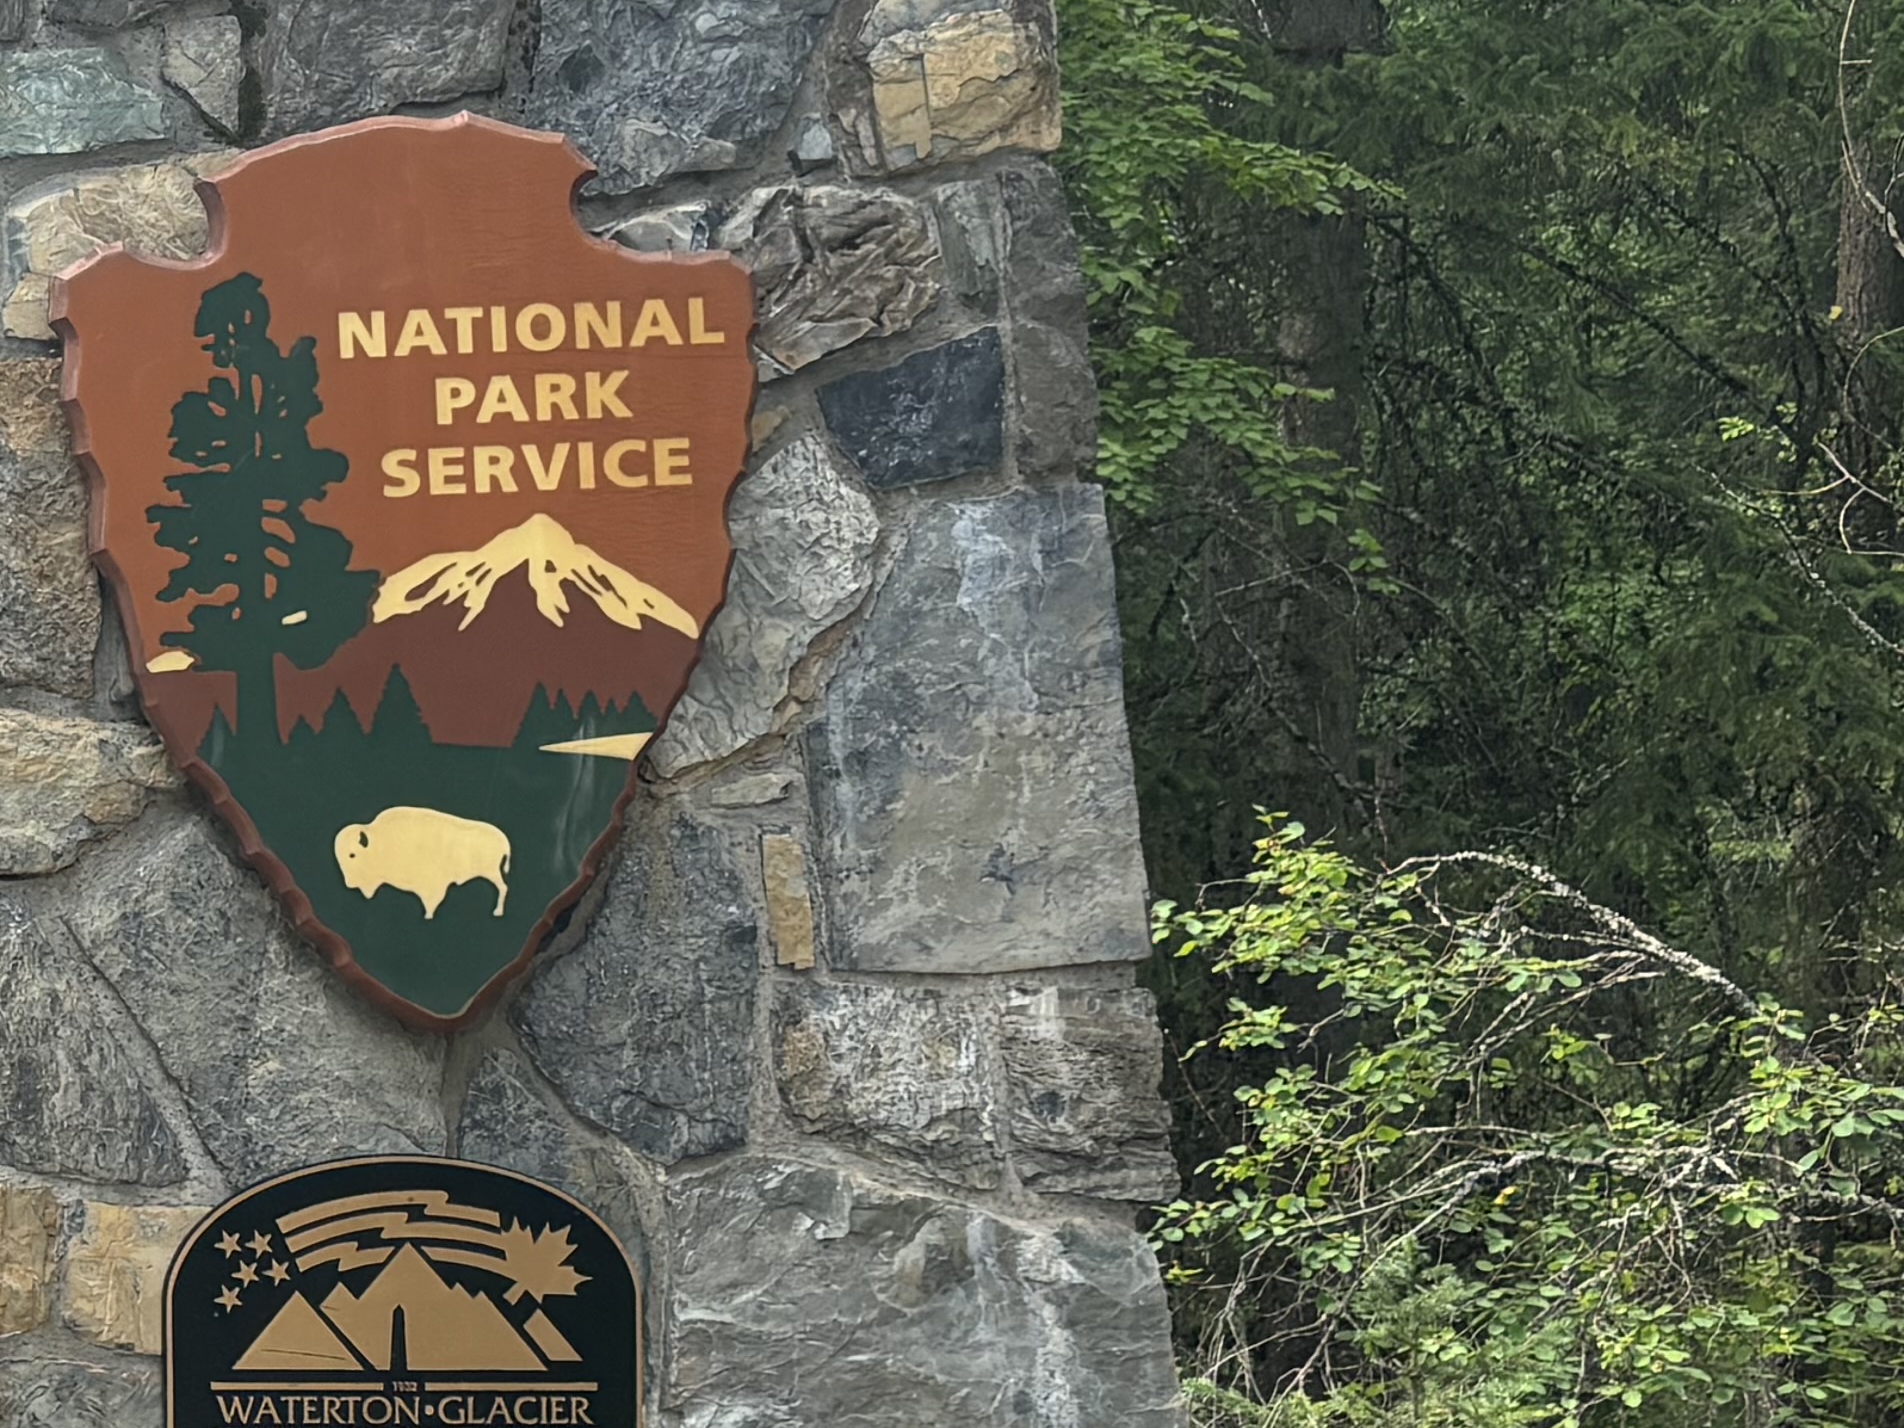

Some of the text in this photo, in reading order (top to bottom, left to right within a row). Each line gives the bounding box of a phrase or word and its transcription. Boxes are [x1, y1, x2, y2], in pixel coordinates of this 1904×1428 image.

[337, 297, 726, 360] NATIONAL
[434, 369, 634, 426] PARK
[380, 437, 694, 498] SERVICE
